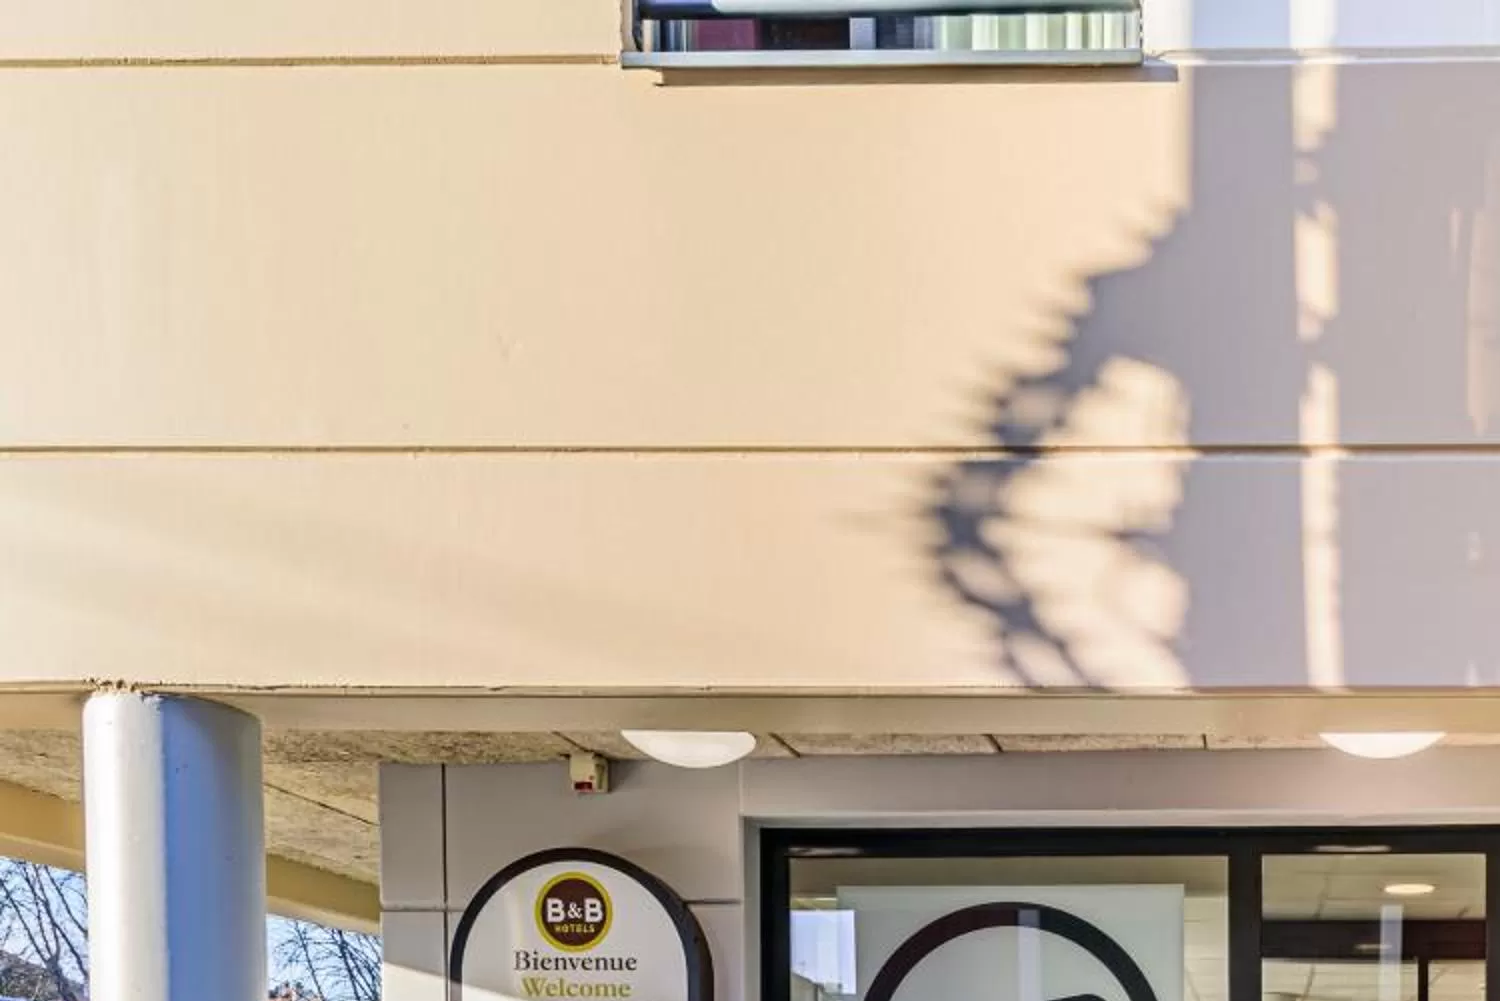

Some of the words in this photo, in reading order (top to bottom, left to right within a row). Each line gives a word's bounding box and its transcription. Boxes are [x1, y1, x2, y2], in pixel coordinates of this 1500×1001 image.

[547, 897, 604, 923] B&B
[555, 924, 596, 934] HOTELS
[514, 950, 638, 971] Bienvenue
[521, 977, 632, 998] Welcome
